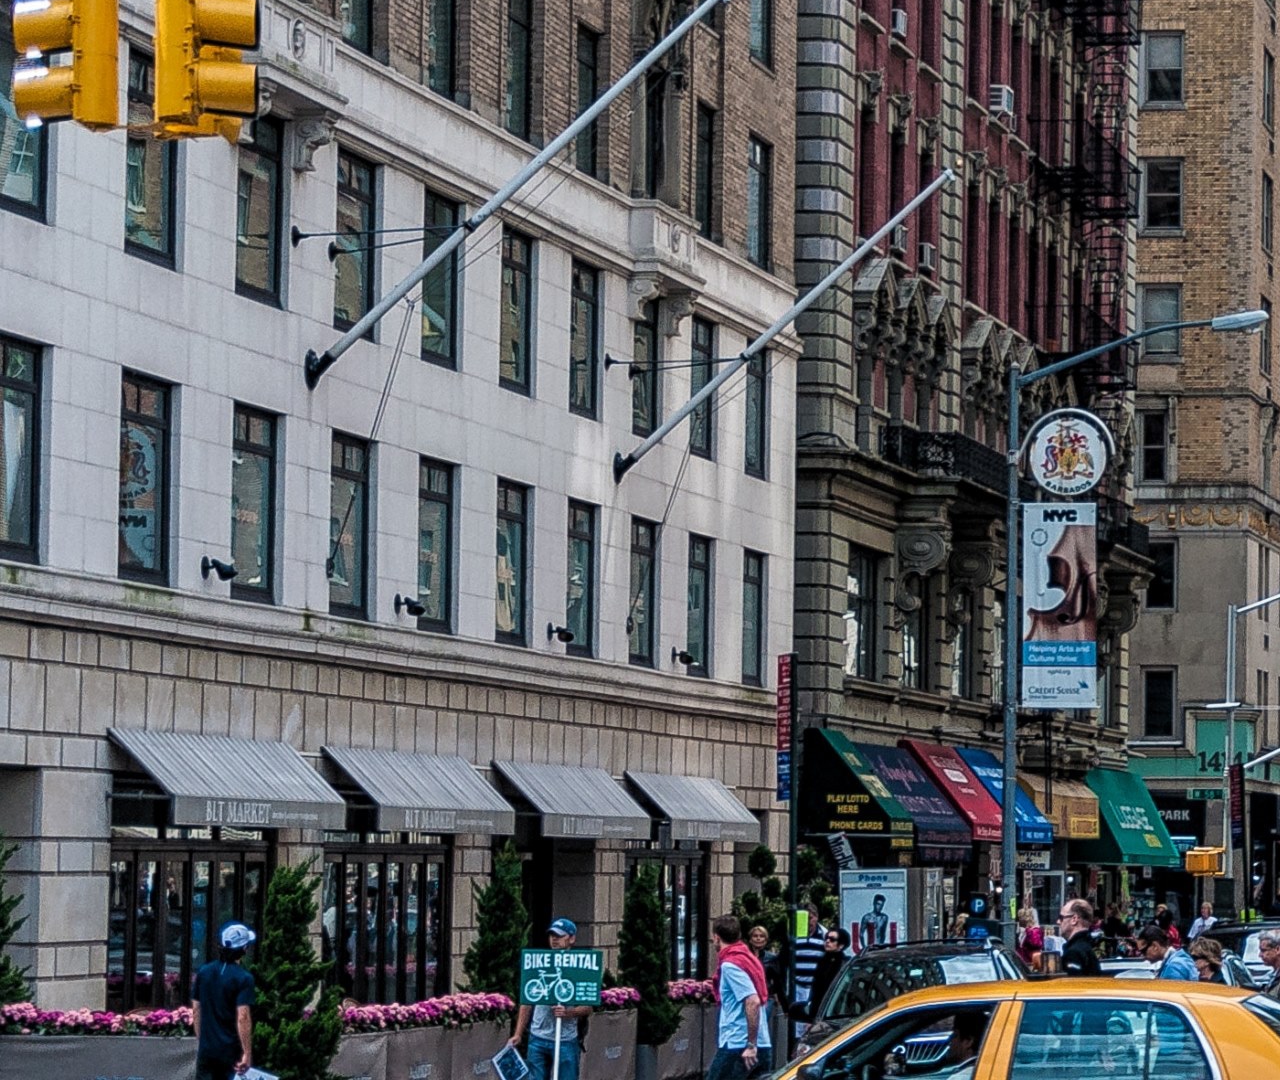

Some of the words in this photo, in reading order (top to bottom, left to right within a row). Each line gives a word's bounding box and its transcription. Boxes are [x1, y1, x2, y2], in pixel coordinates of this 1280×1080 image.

[1045, 480, 1092, 493] BARBADOS
[1043, 509, 1077, 522] NYC
[1029, 644, 1057, 654] Helping
[1058, 644, 1074, 653] Arts
[1075, 645, 1090, 653] and
[1028, 654, 1055, 663] Culture
[1028, 686, 1055, 695] CREDIT
[1056, 686, 1081, 695] SUISSE
[827, 794, 844, 803] PLAY
[846, 794, 869, 803] LOTTO
[206, 801, 224, 822] BLT
[226, 802, 272, 824] MARKET
[837, 805, 859, 813] HERE
[404, 809, 419, 828] BLT
[420, 810, 456, 830] MARKET
[1158, 809, 1190, 820] PARK
[829, 821, 855, 830] PHONE
[857, 822, 883, 831] CARDS
[858, 874, 888, 882] Phone
[975, 898, 985, 913] P
[524, 953, 551, 970] BIKE
[554, 953, 599, 970] RENTAL
